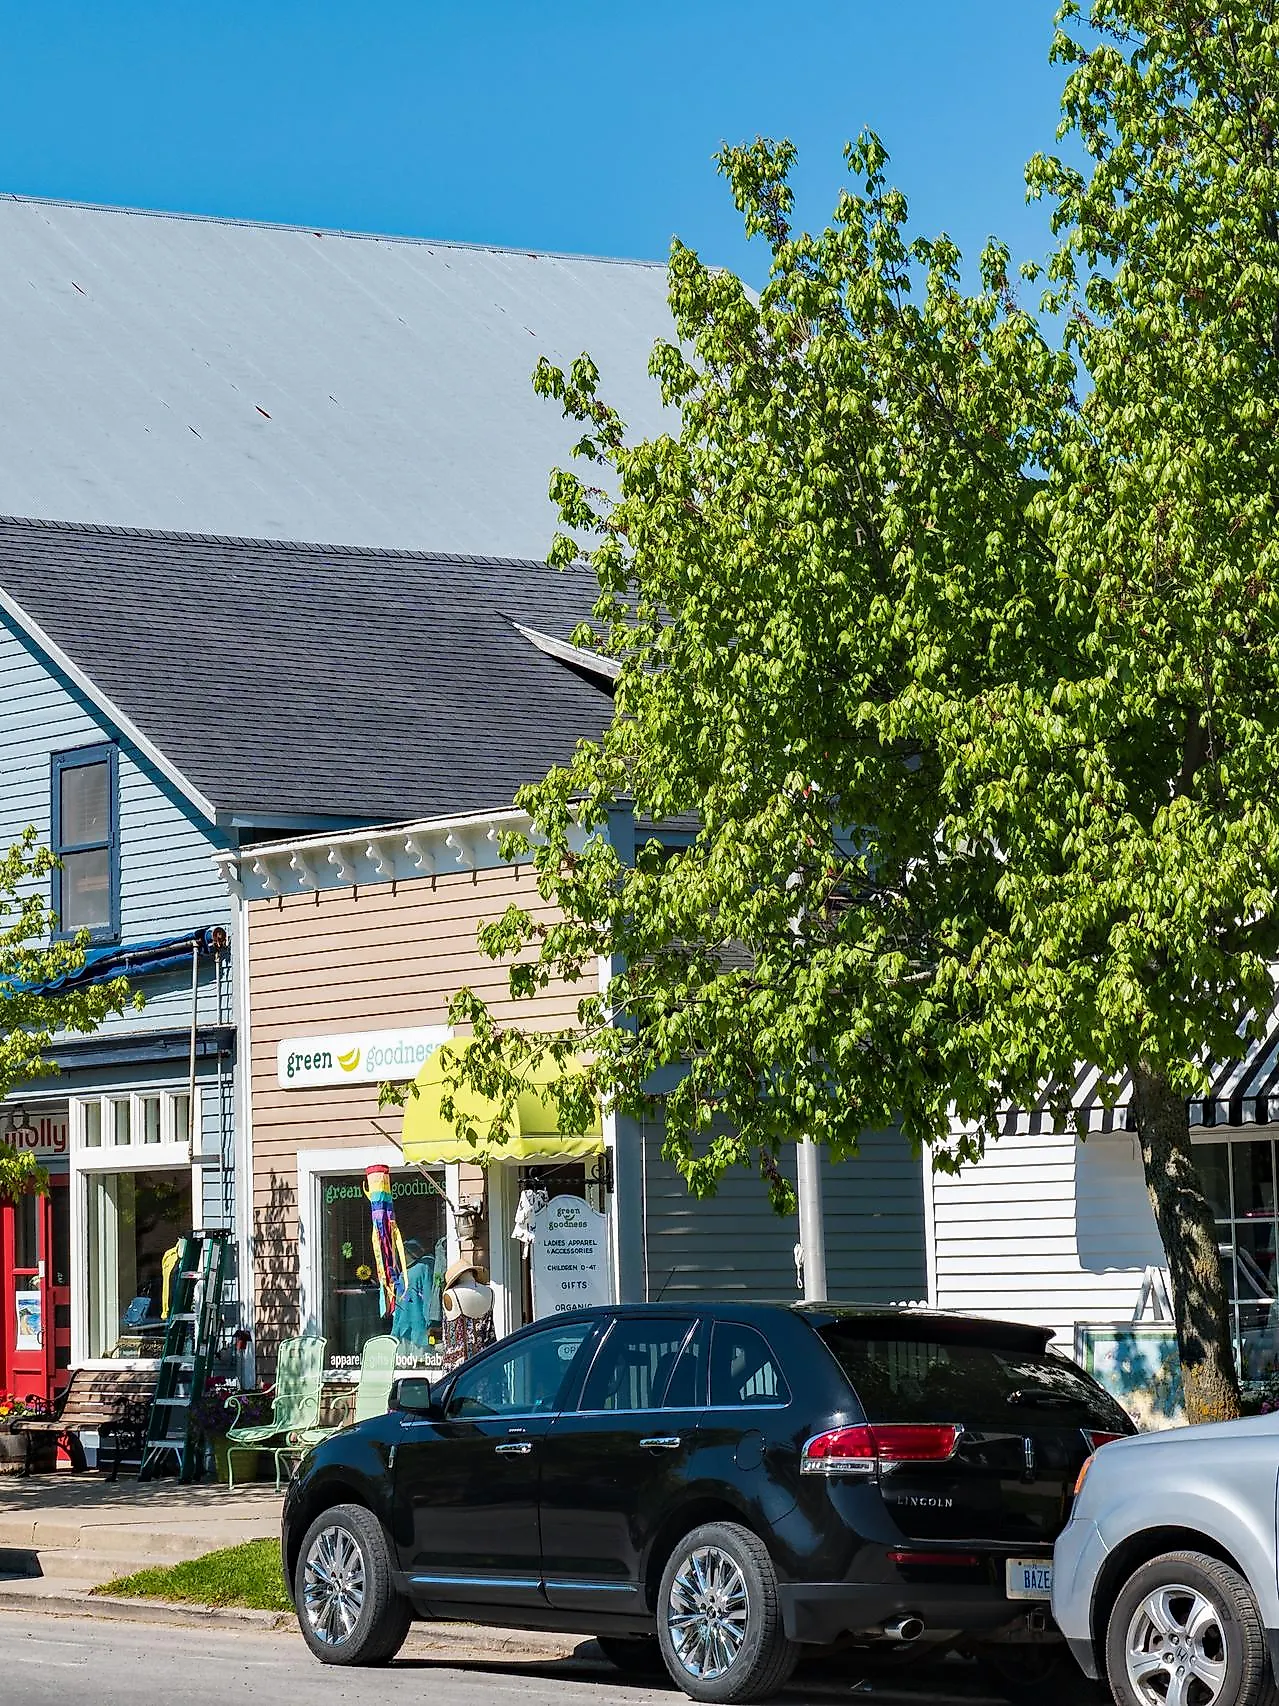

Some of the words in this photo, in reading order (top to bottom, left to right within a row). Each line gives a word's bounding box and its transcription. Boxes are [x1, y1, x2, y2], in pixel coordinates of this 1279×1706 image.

[287, 1051, 332, 1078] green
[366, 1041, 441, 1073] goodnes
[4, 1118, 66, 1152] molly
[326, 1184, 362, 1204] green
[557, 1207, 580, 1217] green
[549, 1221, 587, 1231] goodness
[561, 1280, 588, 1290] GIFTS
[396, 1353, 417, 1368] body
[425, 1352, 444, 1366] bab
[897, 1495, 953, 1508] LINCOLN
